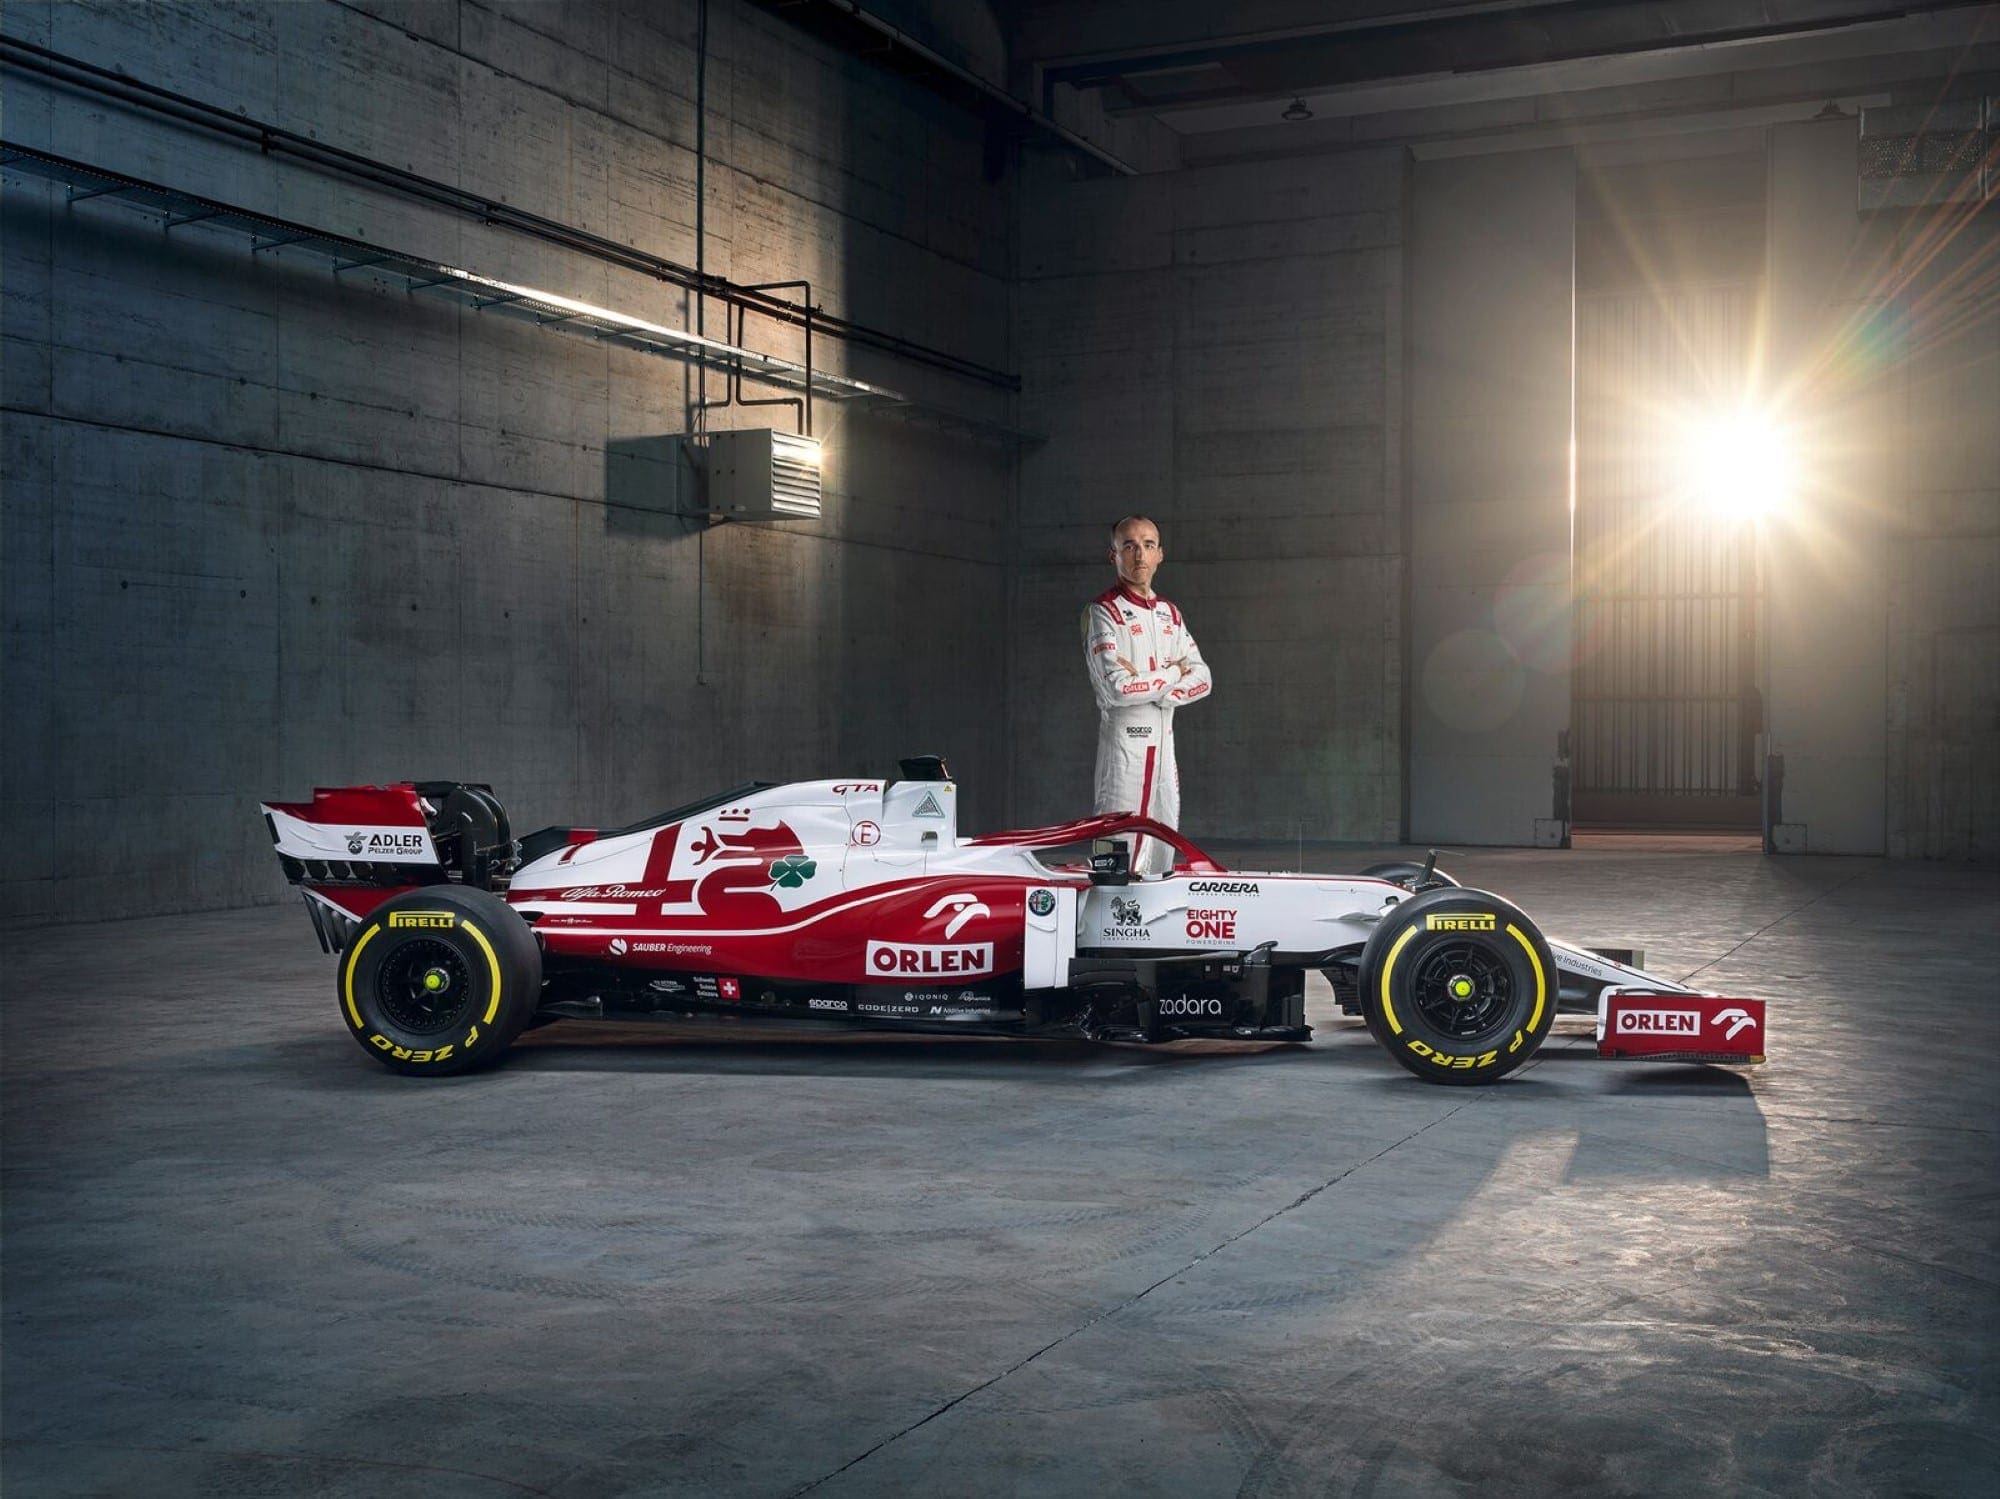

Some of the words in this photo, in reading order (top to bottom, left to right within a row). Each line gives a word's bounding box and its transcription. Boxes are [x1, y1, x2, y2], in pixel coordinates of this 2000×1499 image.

[832, 784, 879, 796] GTA
[369, 834, 423, 847] ADLER
[860, 824, 872, 844] E
[560, 886, 599, 902] Alfa
[600, 884, 667, 898] Romeo
[1188, 881, 1259, 894] CARRERA
[389, 911, 455, 928] PIRELLI
[1187, 909, 1238, 921] EIGHTY
[1426, 913, 1496, 931] PIRELLI
[1103, 927, 1151, 937] SINGHA
[1186, 920, 1236, 939] ONE
[632, 943, 666, 952] SAUBER
[667, 943, 712, 955] Engineering
[873, 947, 985, 973] ORLEN
[1563, 955, 1603, 977] Industries
[809, 999, 848, 1010] sparco
[1159, 993, 1221, 1015] zadara
[1621, 1013, 1695, 1031] ORLEN
[465, 1025, 478, 1048] P
[1509, 1029, 1523, 1053] P
[369, 1034, 454, 1062] ZERO
[1407, 1040, 1498, 1068] ZERO
